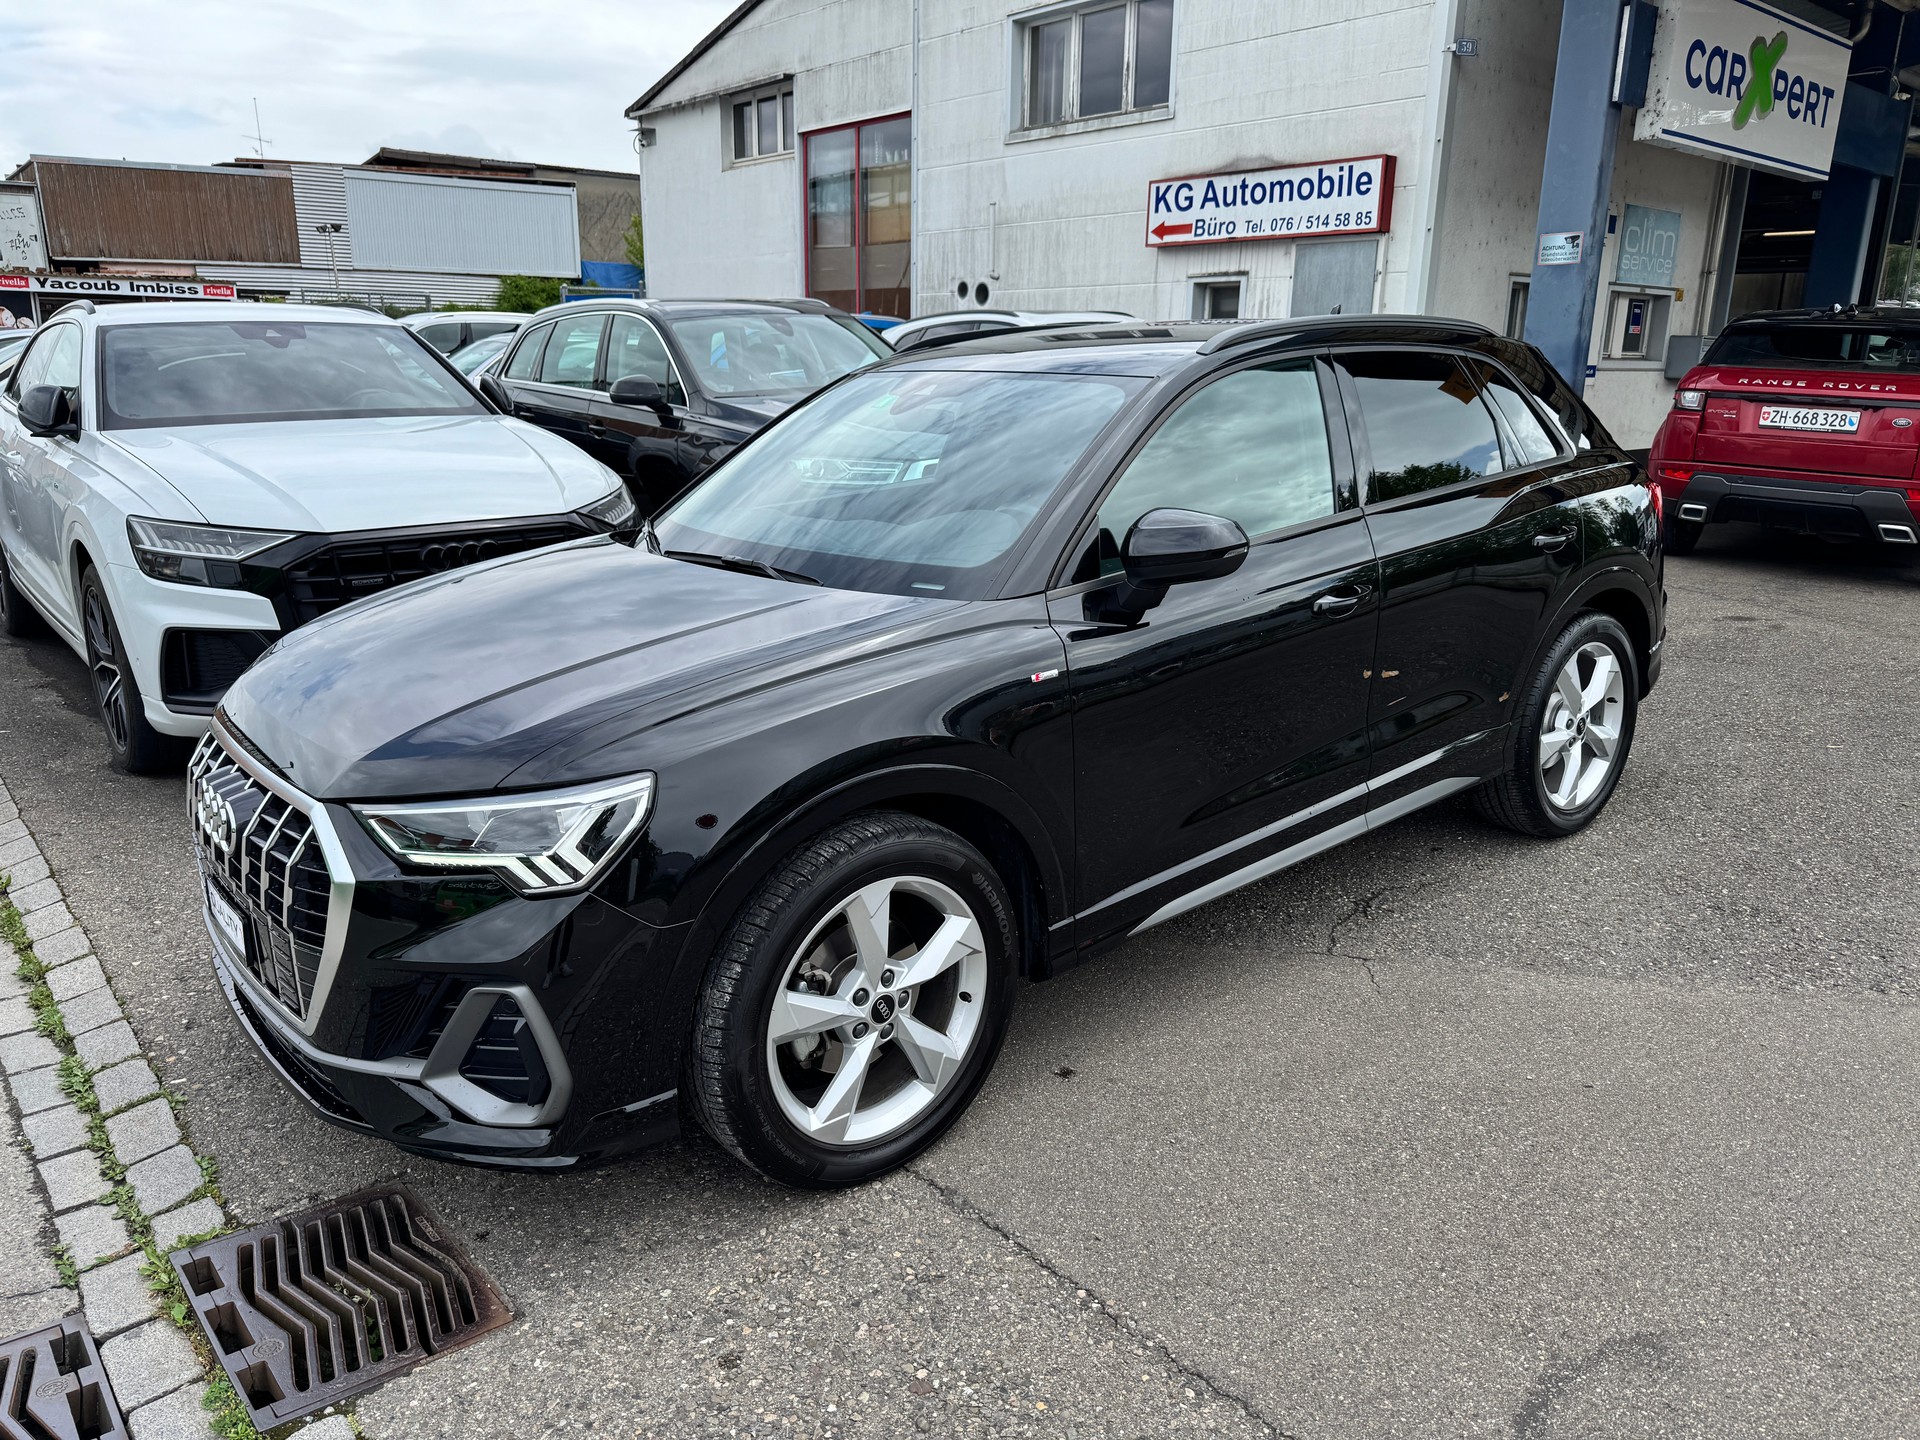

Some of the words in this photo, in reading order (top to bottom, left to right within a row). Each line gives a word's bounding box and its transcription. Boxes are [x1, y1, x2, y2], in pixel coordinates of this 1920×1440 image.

[1154, 183, 1194, 214] KG
[1200, 164, 1373, 210] Automobile
[1193, 218, 1236, 238] Büro
[1245, 220, 1266, 234] Tel.
[1270, 217, 1293, 231] 076
[1306, 214, 1329, 230] 514
[1334, 213, 1351, 228] 58
[1355, 211, 1372, 226] 85
[1625, 217, 1676, 258] clim
[1621, 253, 1673, 274] service
[34, 277, 121, 292] Yacoub
[129, 281, 199, 295] Imbiss
[206, 287, 232, 295] rivella
[1738, 378, 1807, 387] RANGE
[1822, 381, 1897, 391] ROVER
[979, 879, 1013, 959] Hankook
